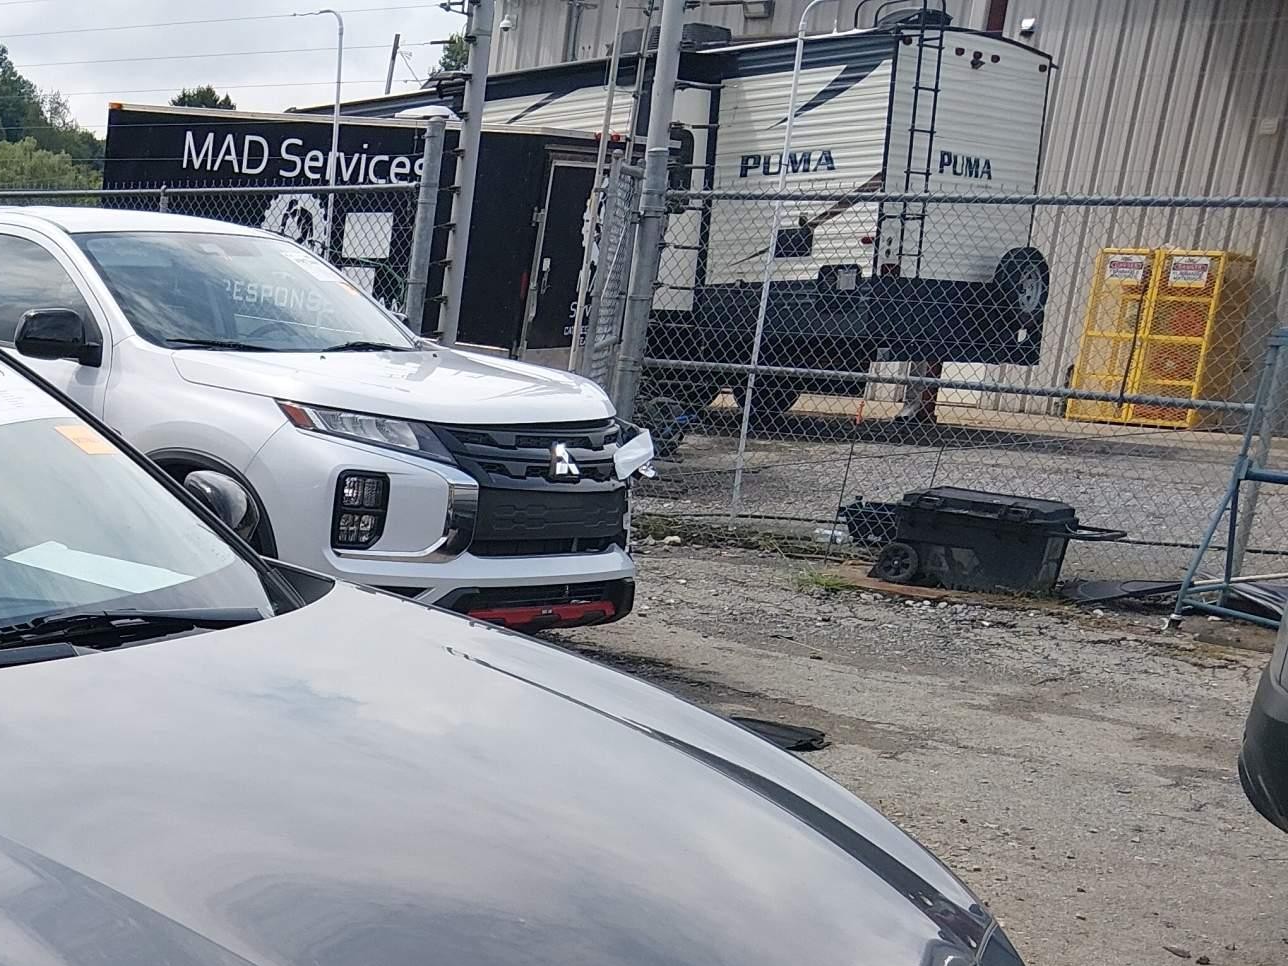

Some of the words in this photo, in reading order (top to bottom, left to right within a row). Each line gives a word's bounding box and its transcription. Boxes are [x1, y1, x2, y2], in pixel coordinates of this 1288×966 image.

[182, 130, 270, 175] MAD
[739, 149, 837, 178] PUMA
[938, 150, 993, 181] PUMA
